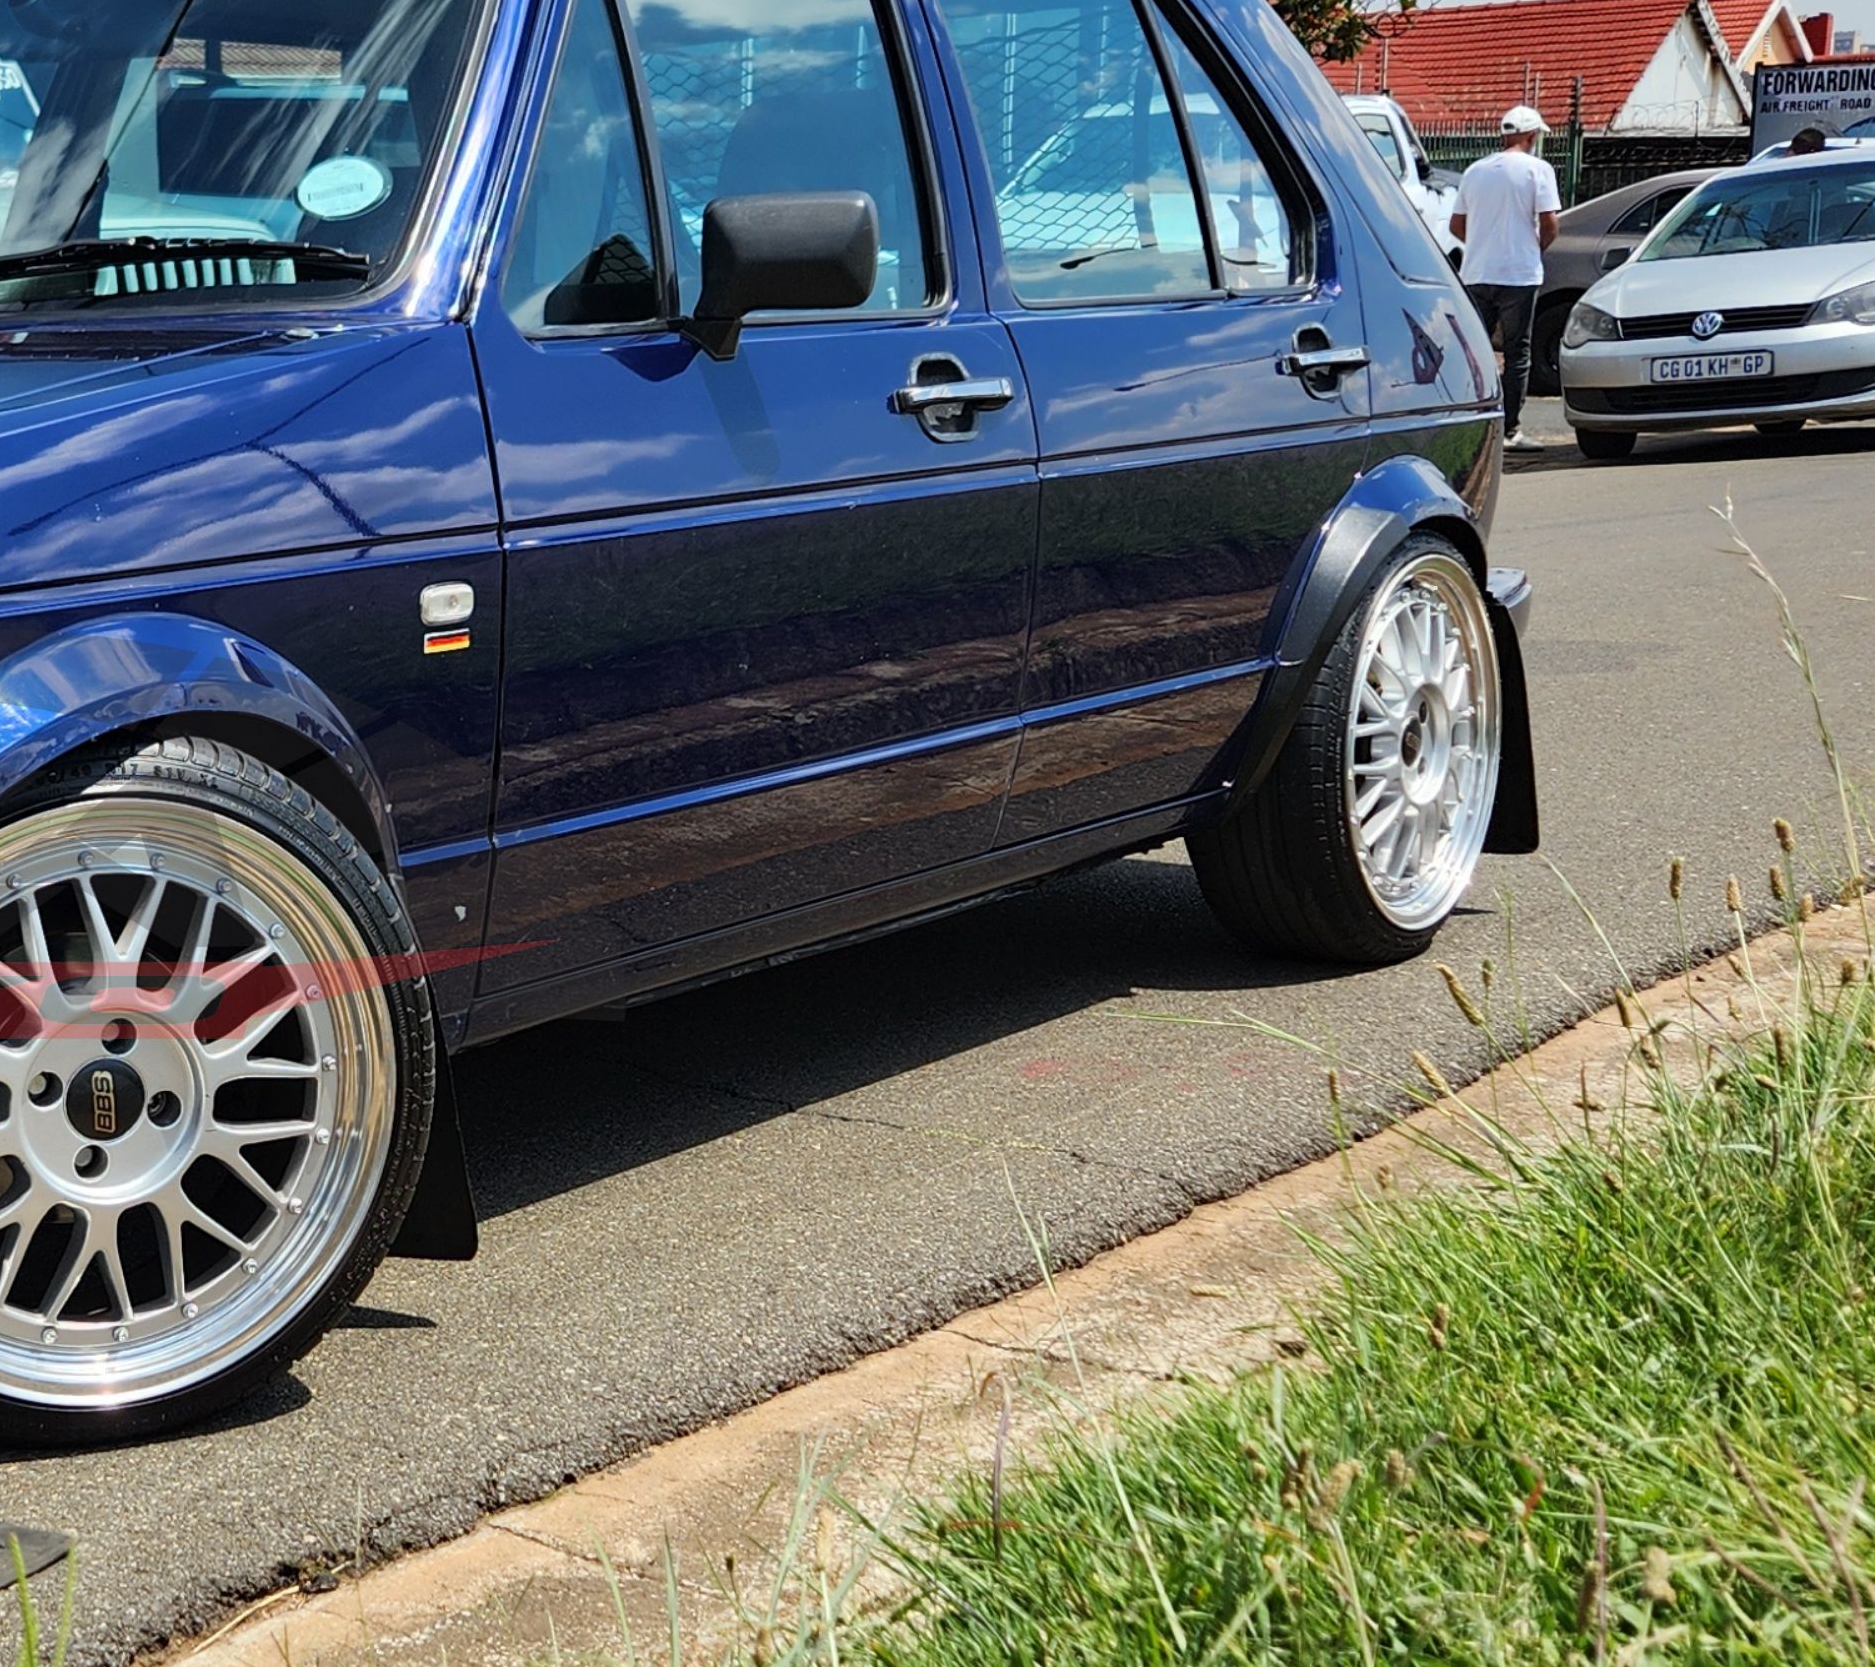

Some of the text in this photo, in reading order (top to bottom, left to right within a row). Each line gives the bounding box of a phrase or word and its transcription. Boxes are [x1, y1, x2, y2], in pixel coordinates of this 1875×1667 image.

[1760, 97, 1872, 114] AIR FREIGHT ROAD
[1659, 360, 1681, 379] CG
[1707, 357, 1729, 376] KH
[1743, 355, 1764, 374] GP
[91, 1069, 117, 1134] BBS
